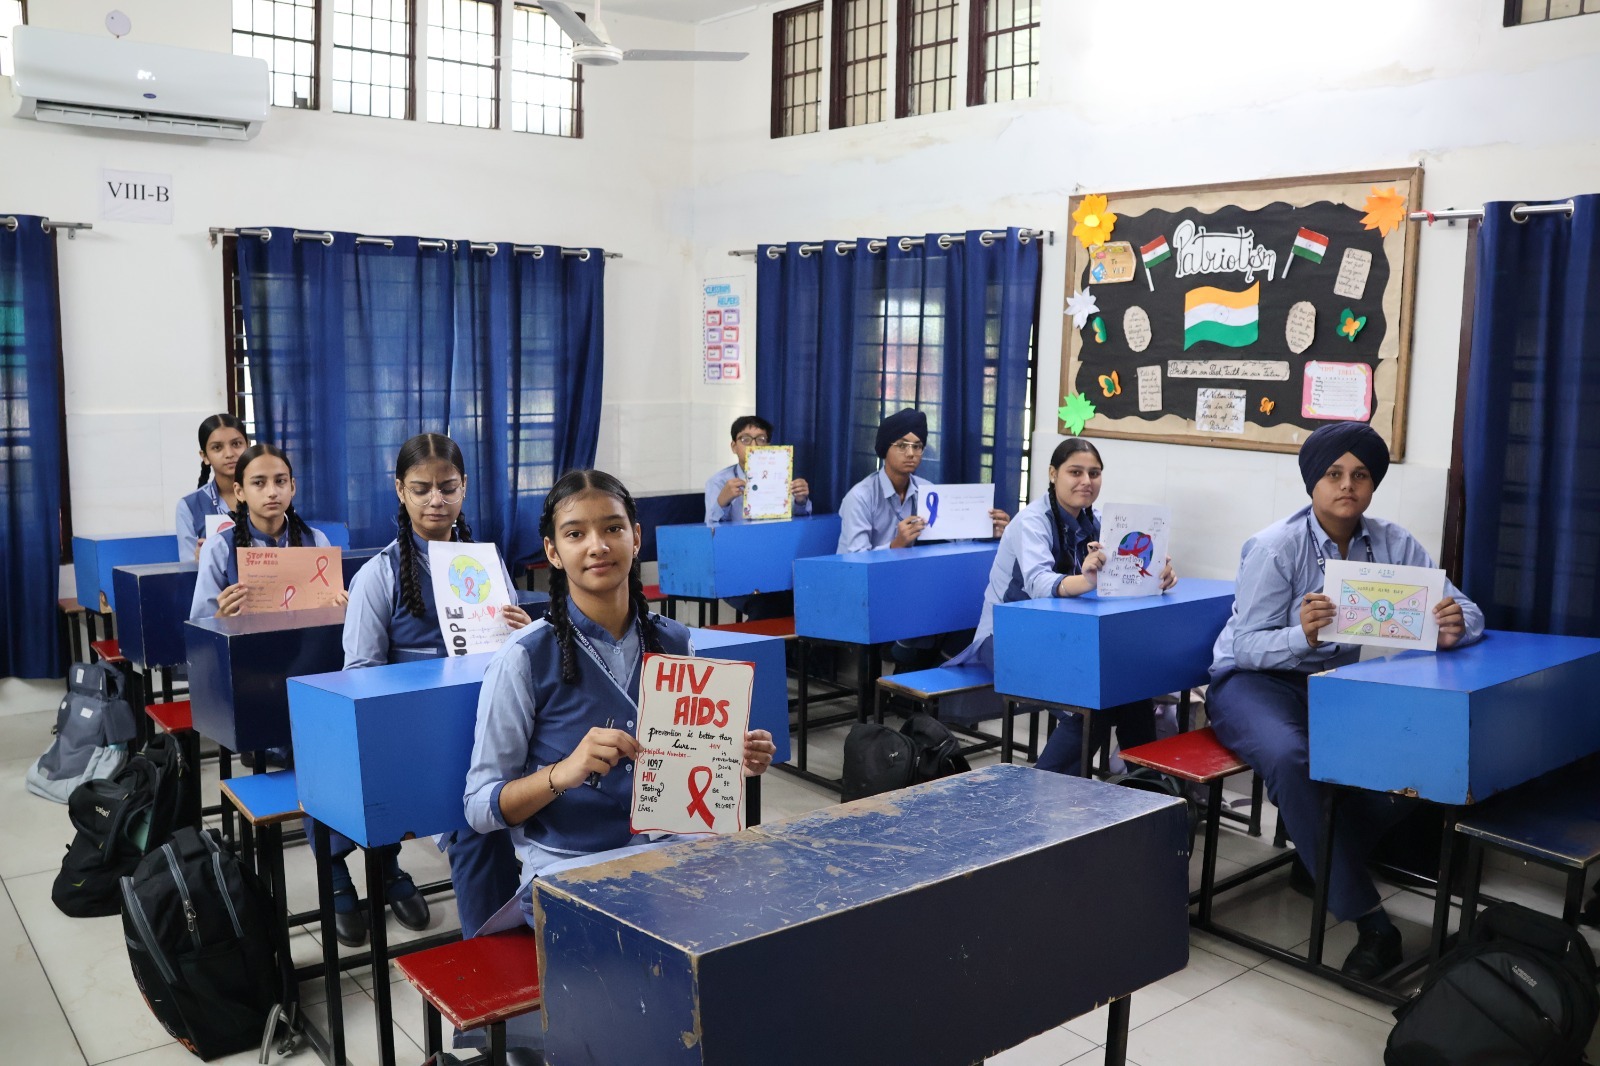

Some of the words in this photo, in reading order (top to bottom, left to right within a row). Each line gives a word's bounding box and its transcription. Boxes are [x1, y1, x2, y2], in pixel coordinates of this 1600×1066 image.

[107, 180, 170, 203] VIII-B
[1175, 222, 1275, 281] Patriotism
[246, 552, 263, 560] STOP
[656, 662, 714, 694] HIV
[673, 696, 730, 728] AIDS
[688, 730, 693, 739] is
[698, 729, 715, 740] better
[719, 730, 733, 745] than
[647, 759, 663, 769] 1097
[642, 771, 657, 783] HIV
[642, 782, 665, 797] Testing
